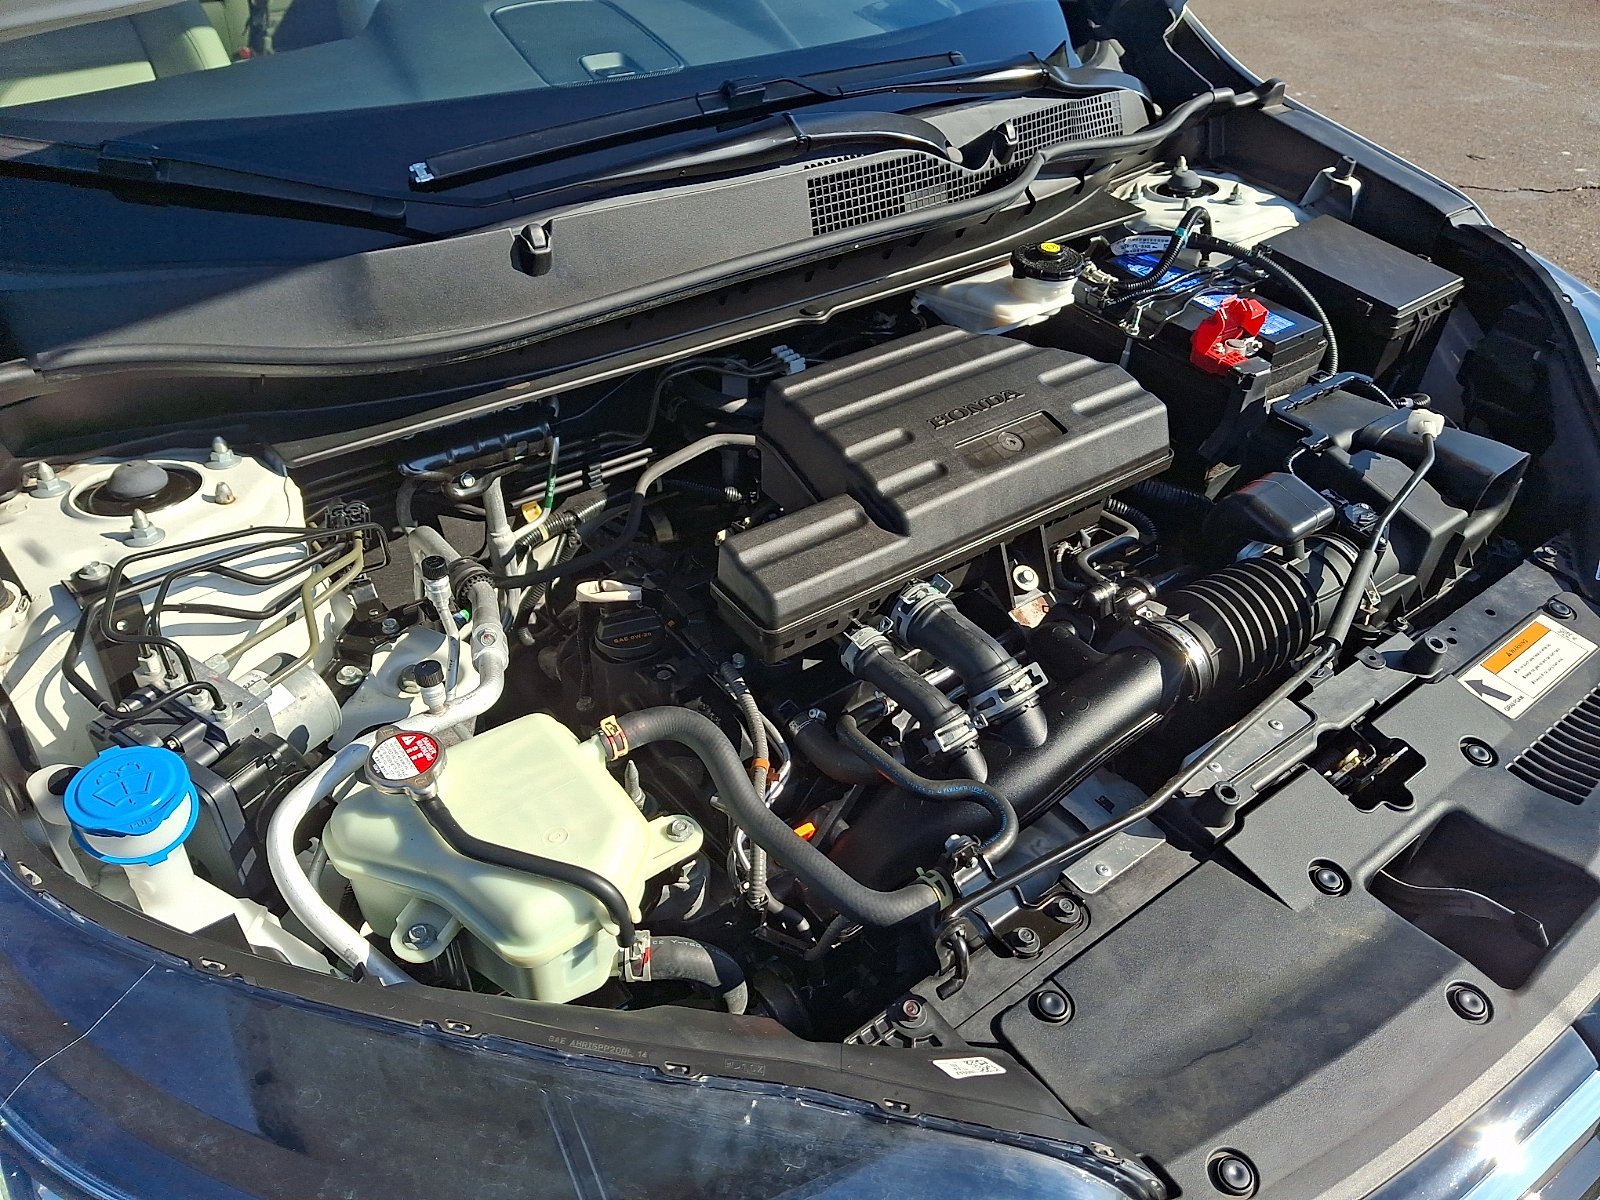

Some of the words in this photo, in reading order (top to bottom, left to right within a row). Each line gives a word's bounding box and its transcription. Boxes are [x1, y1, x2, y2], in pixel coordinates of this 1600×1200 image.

[926, 389, 1025, 430] HONDA
[630, 632, 652, 640] 0W-20
[548, 1035, 567, 1045] SAE
